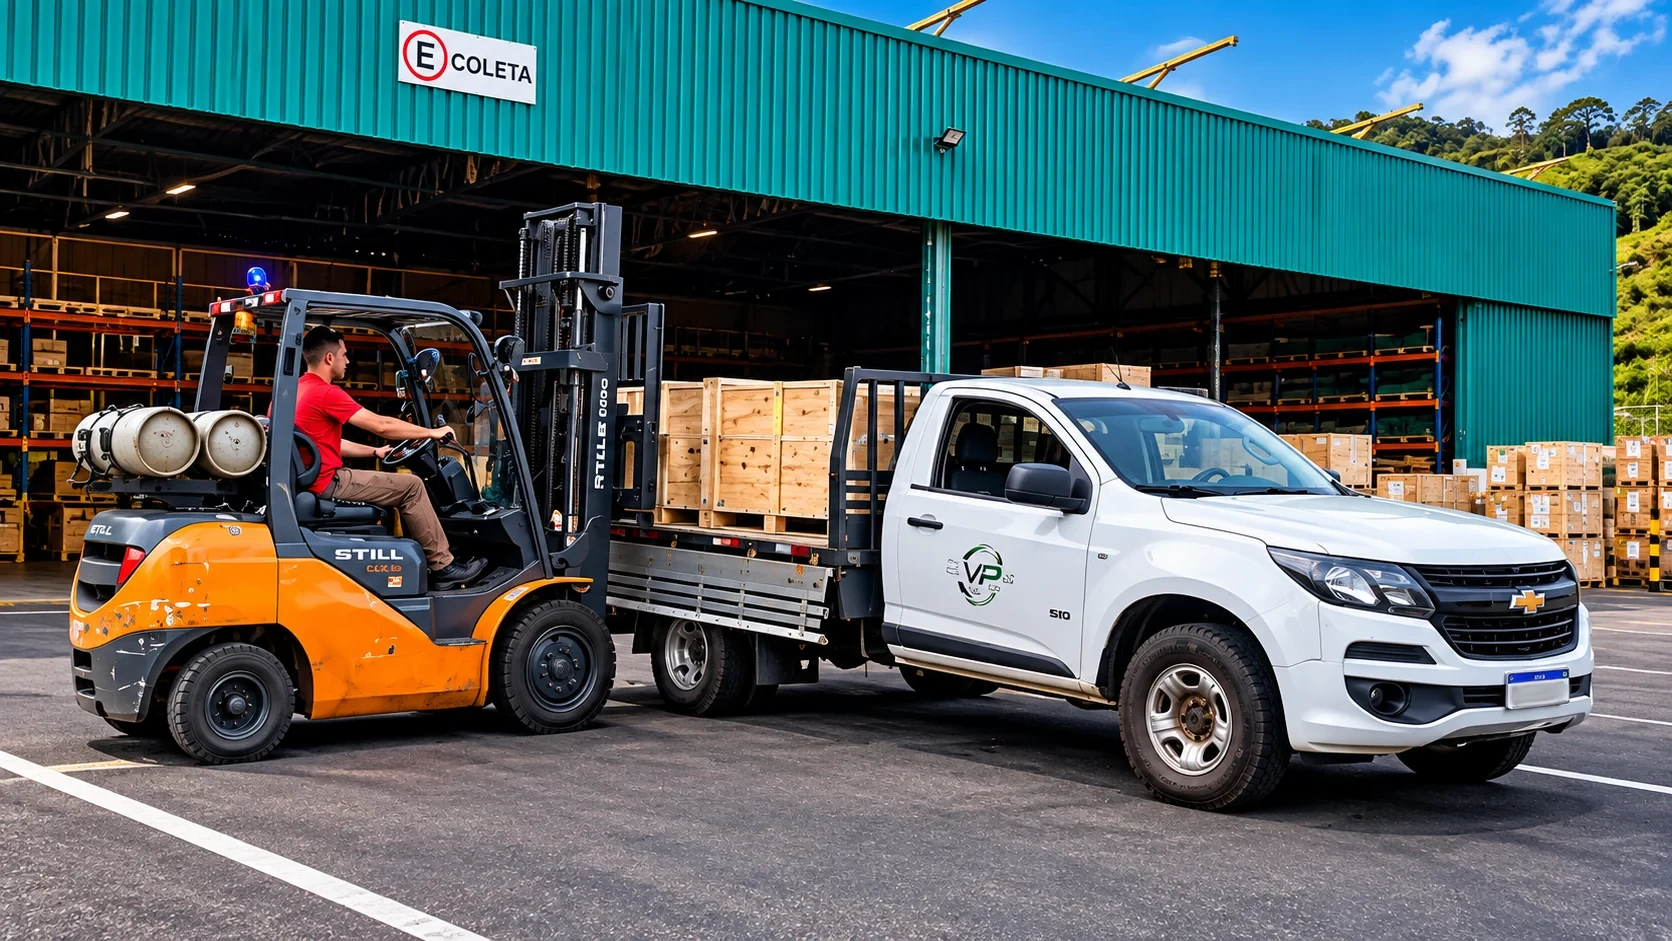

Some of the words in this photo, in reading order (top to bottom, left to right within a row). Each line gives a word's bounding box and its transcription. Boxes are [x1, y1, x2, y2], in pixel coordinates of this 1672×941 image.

[417, 40, 435, 70] E
[451, 53, 532, 84] COLETA
[334, 548, 404, 560] STILL
[963, 561, 1003, 586] VP
